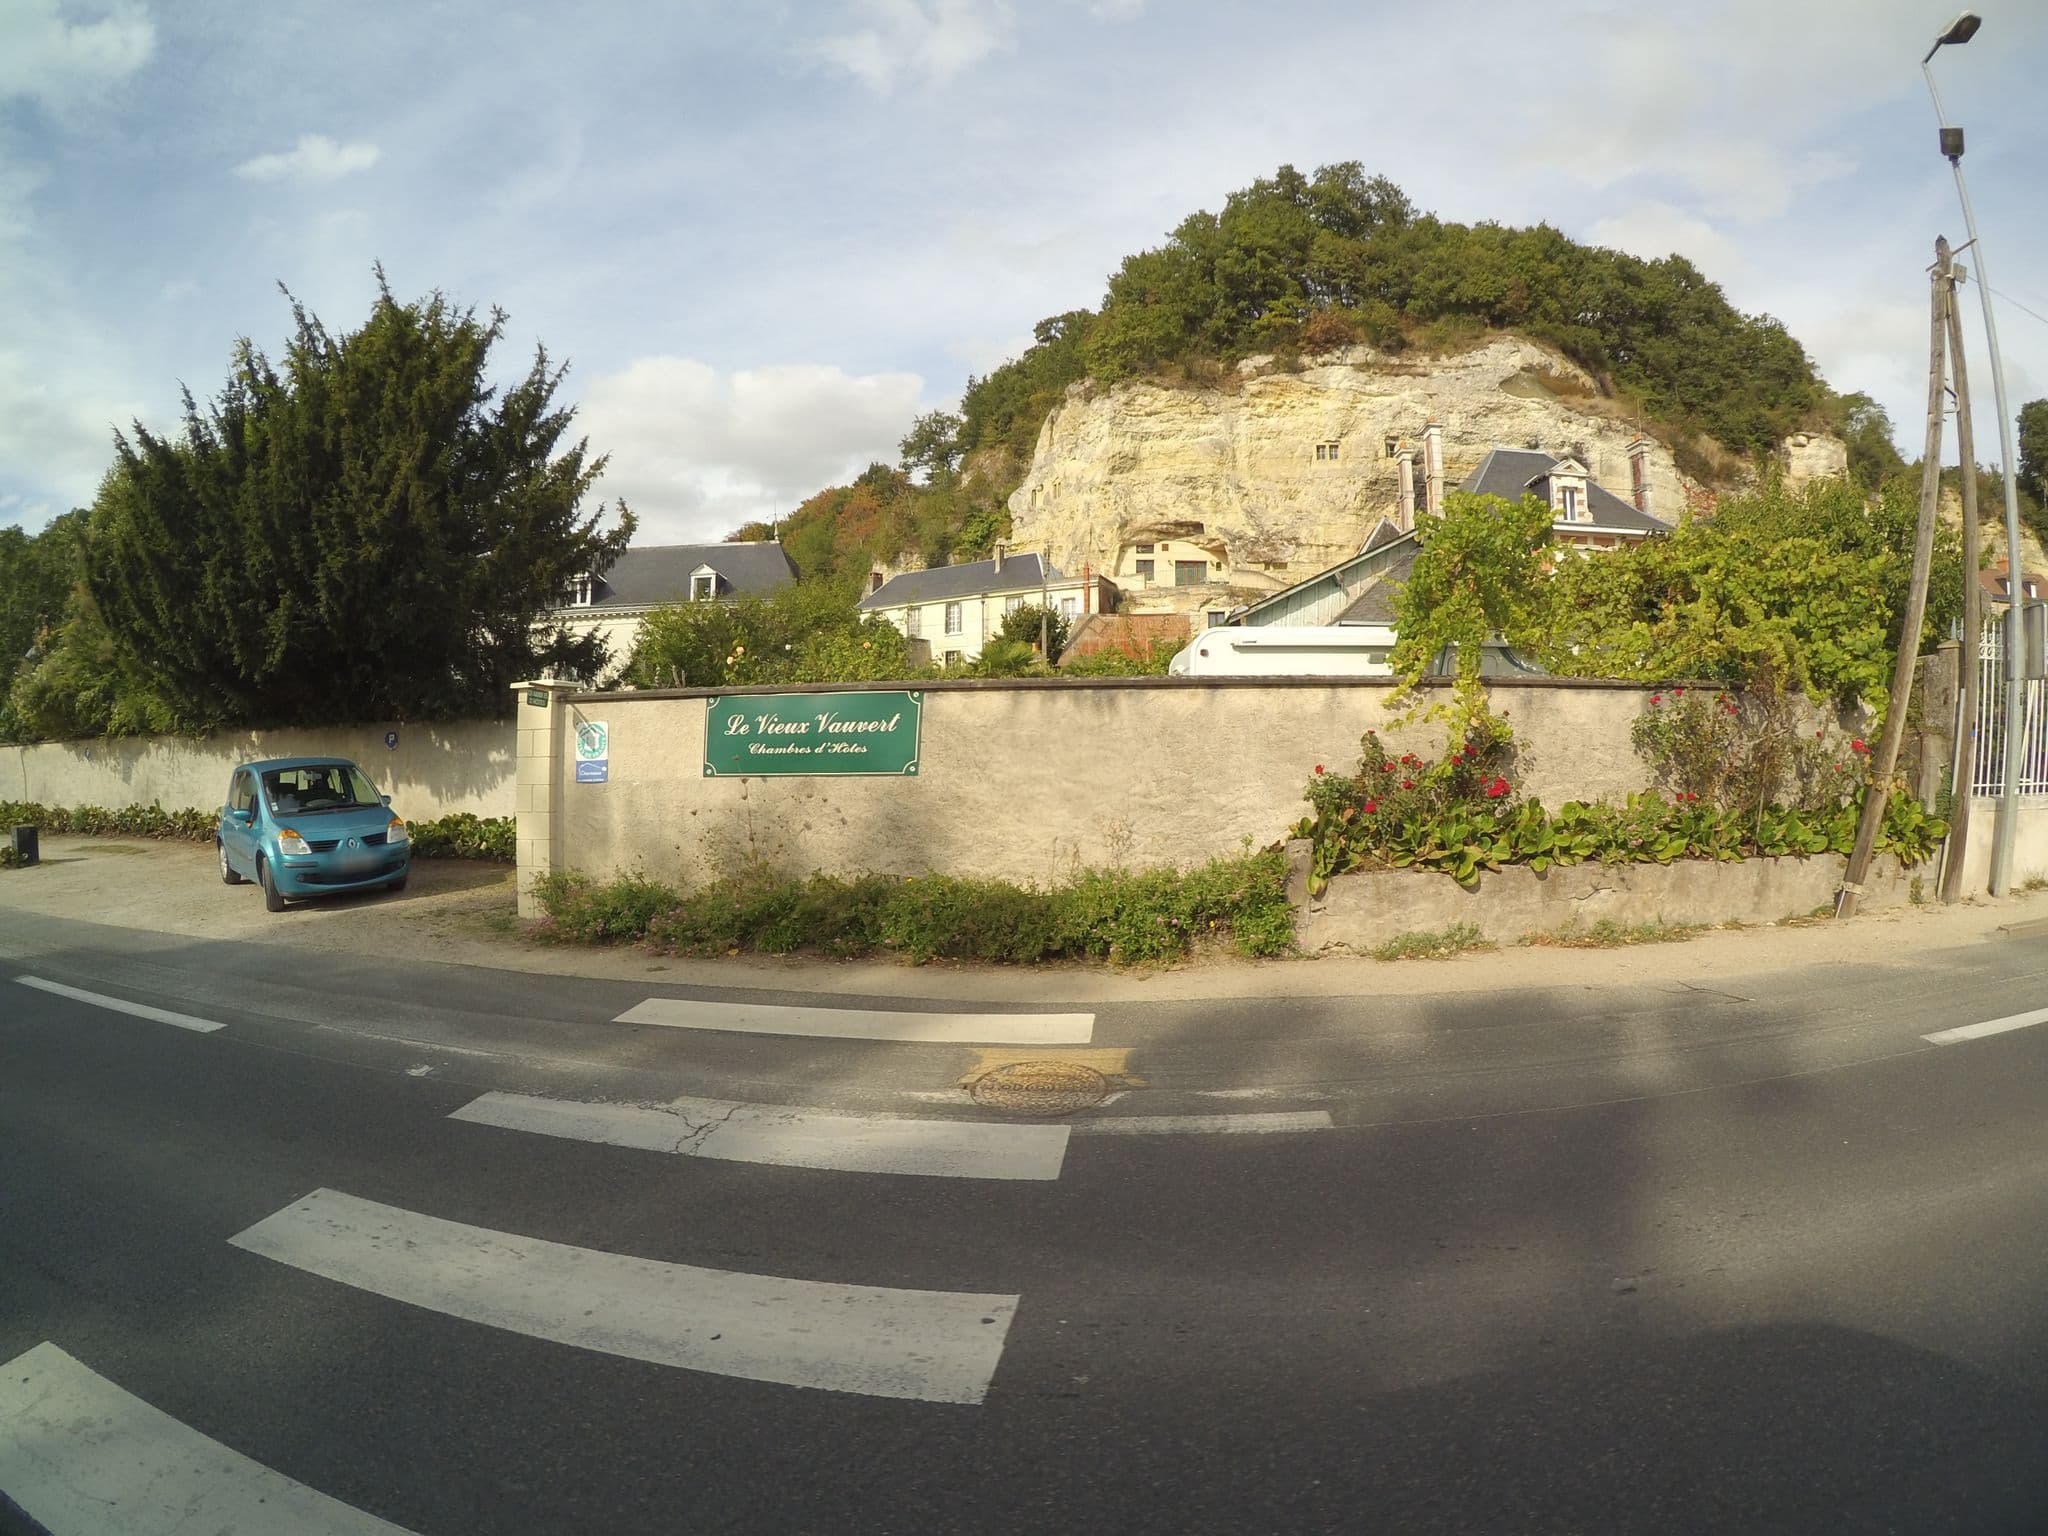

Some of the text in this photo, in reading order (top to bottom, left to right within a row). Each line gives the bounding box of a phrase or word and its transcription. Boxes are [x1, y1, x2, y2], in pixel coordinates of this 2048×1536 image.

[724, 711, 901, 736] Le Vieux Vauvert
[388, 734, 395, 744] P
[748, 741, 868, 755] Chambres d'Hôtes
